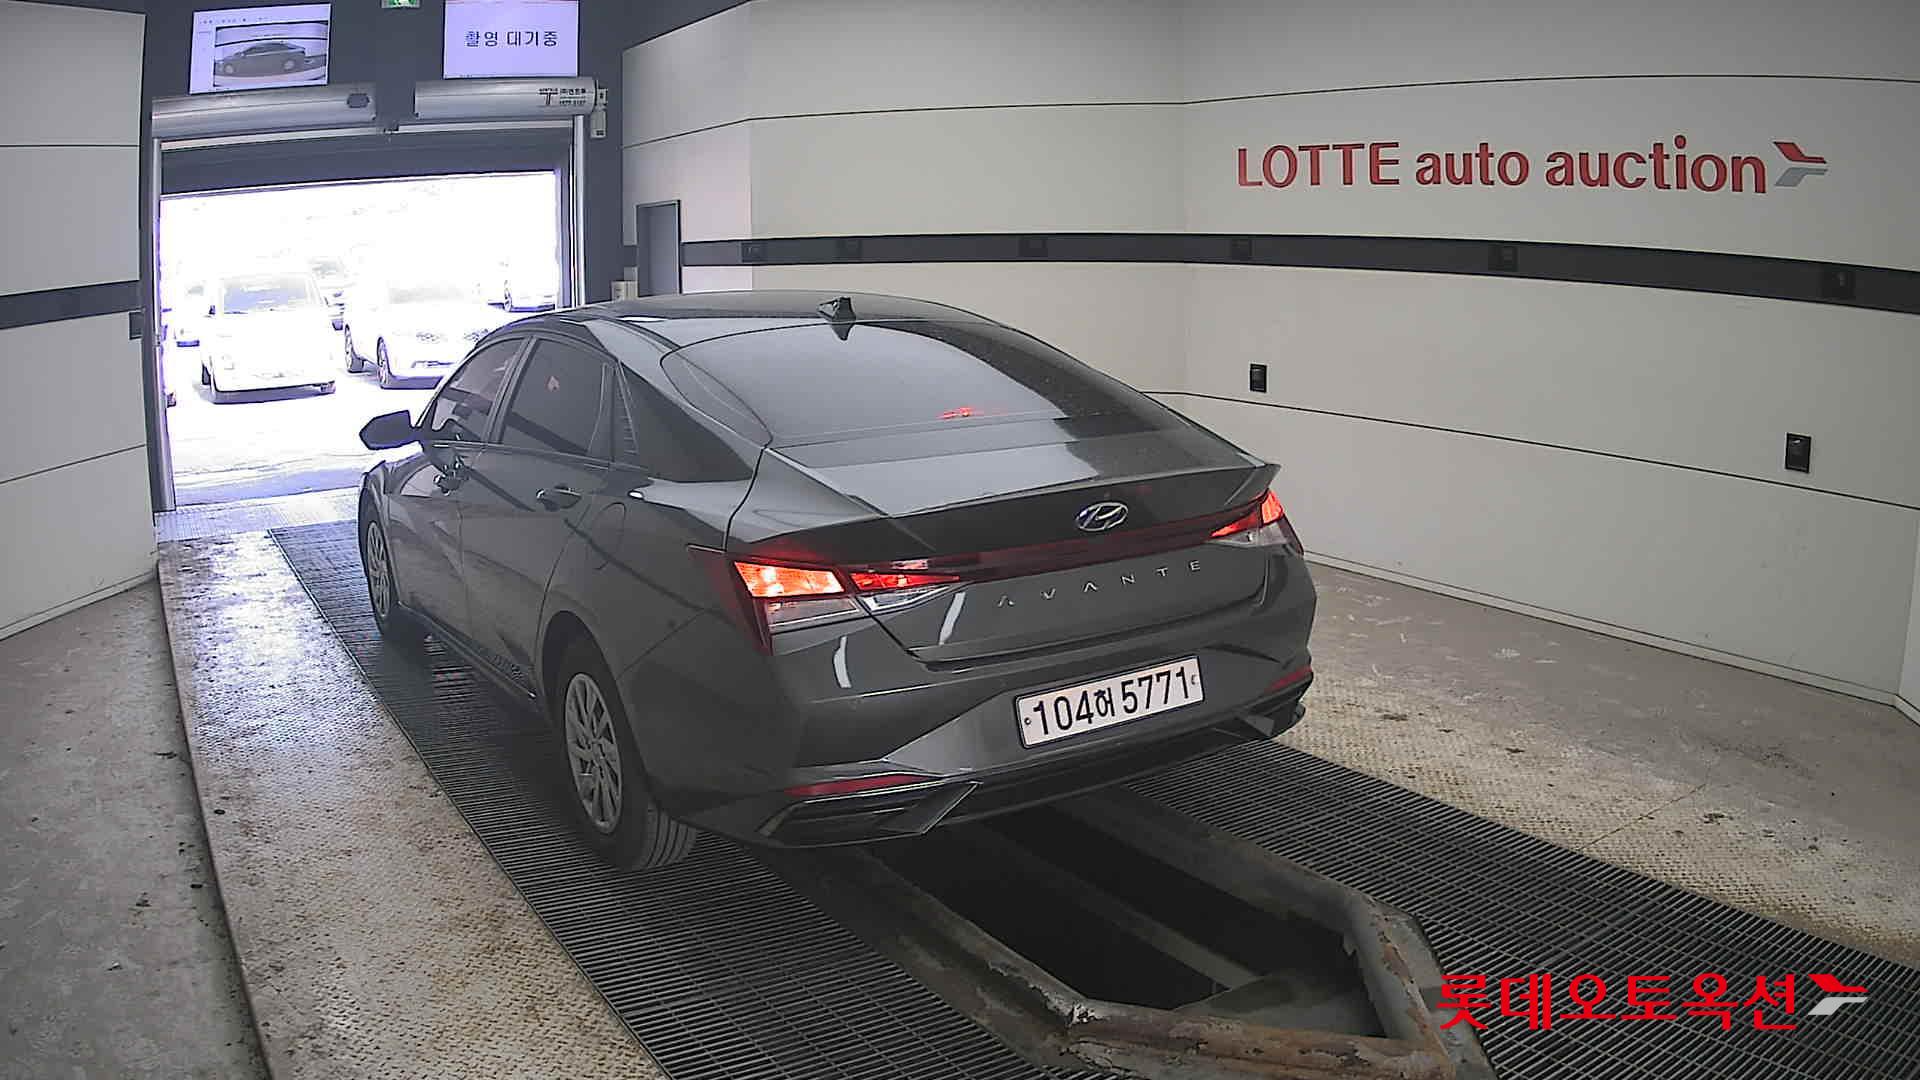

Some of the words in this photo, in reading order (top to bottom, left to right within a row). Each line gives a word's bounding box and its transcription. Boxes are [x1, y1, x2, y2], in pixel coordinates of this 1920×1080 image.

[506, 31, 558, 47] 대기중
[1236, 141, 1401, 188] LOTTE
[1415, 141, 1530, 187] auto
[1545, 135, 1767, 194] auction
[996, 559, 1202, 609] AVANTE
